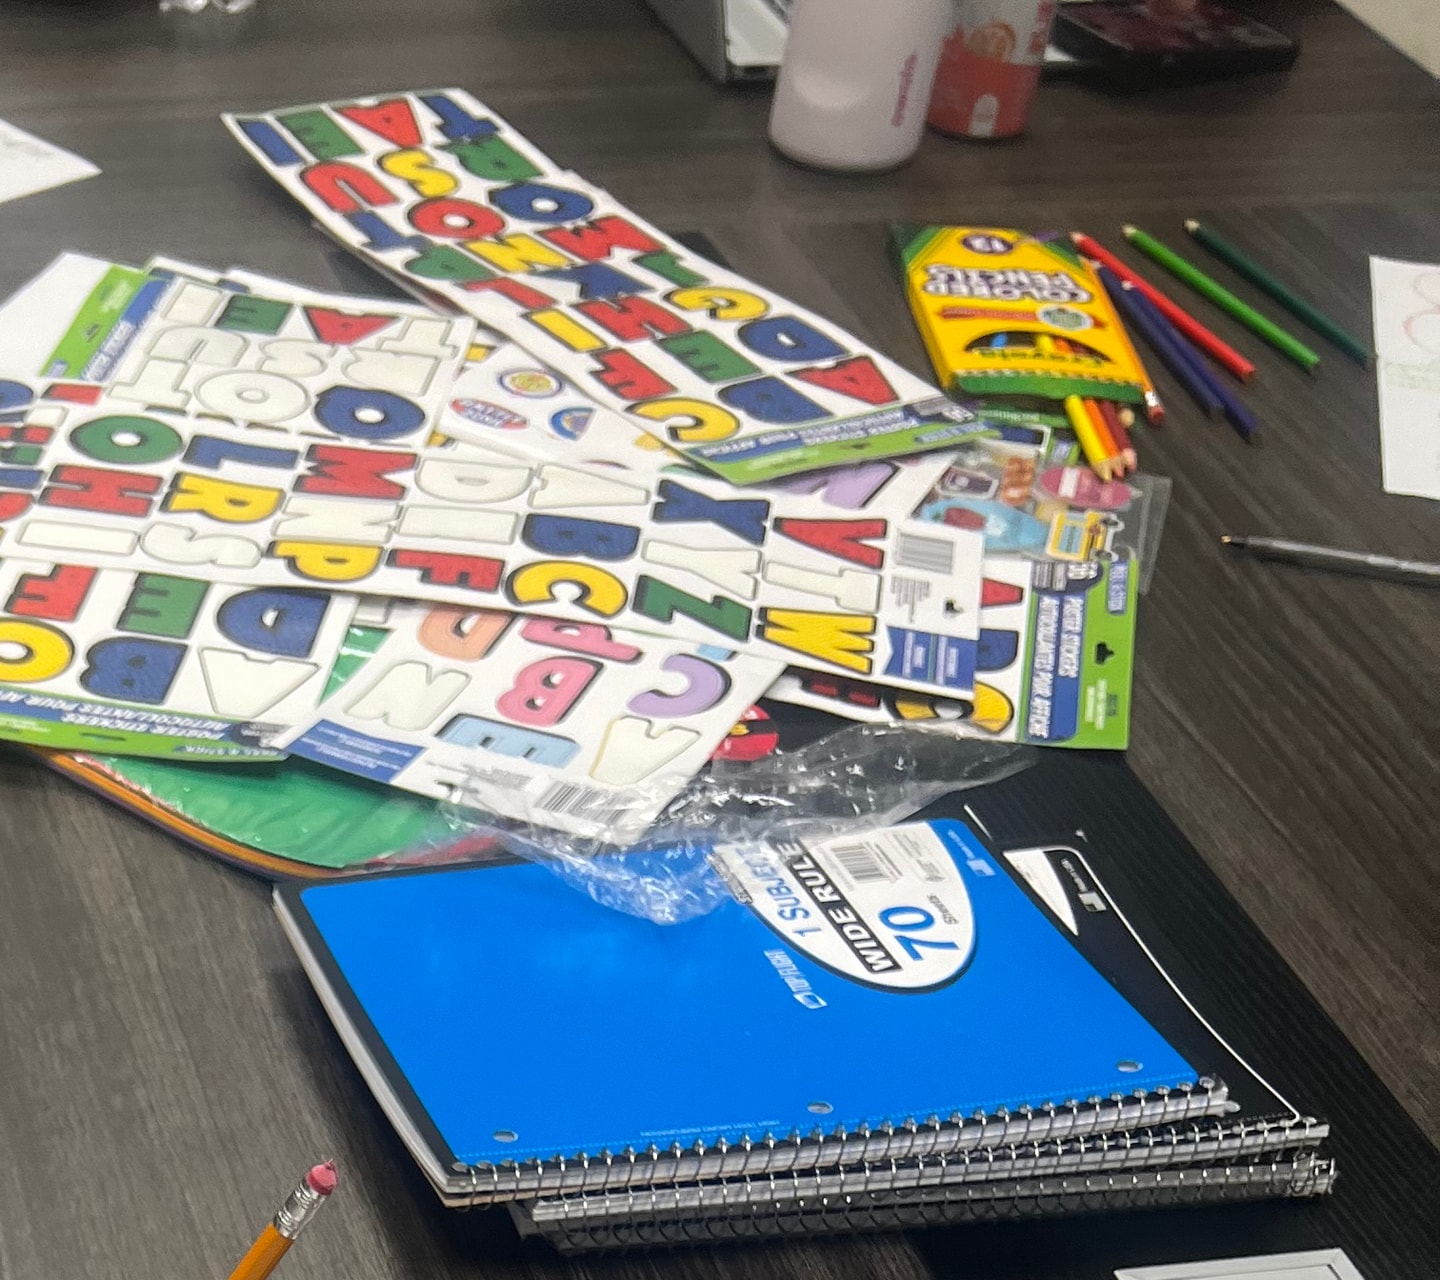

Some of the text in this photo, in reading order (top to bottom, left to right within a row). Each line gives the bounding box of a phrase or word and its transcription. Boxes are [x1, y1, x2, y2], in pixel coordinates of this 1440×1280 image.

[282, 109, 366, 164] E
[334, 99, 421, 150] A
[377, 149, 459, 199] S
[791, 353, 901, 405] A
[629, 399, 741, 445] C
[40, 462, 163, 518] H
[165, 472, 286, 524] R
[521, 512, 641, 561] B
[4, 564, 99, 622] F
[388, 547, 506, 592] F
[504, 559, 629, 619] C
[116, 569, 210, 639] E
[215, 586, 332, 659] D
[79, 635, 188, 704] B
[791, 927, 822, 937] 1
[828, 908, 894, 970] WIDE
[878, 905, 959, 961] 70
